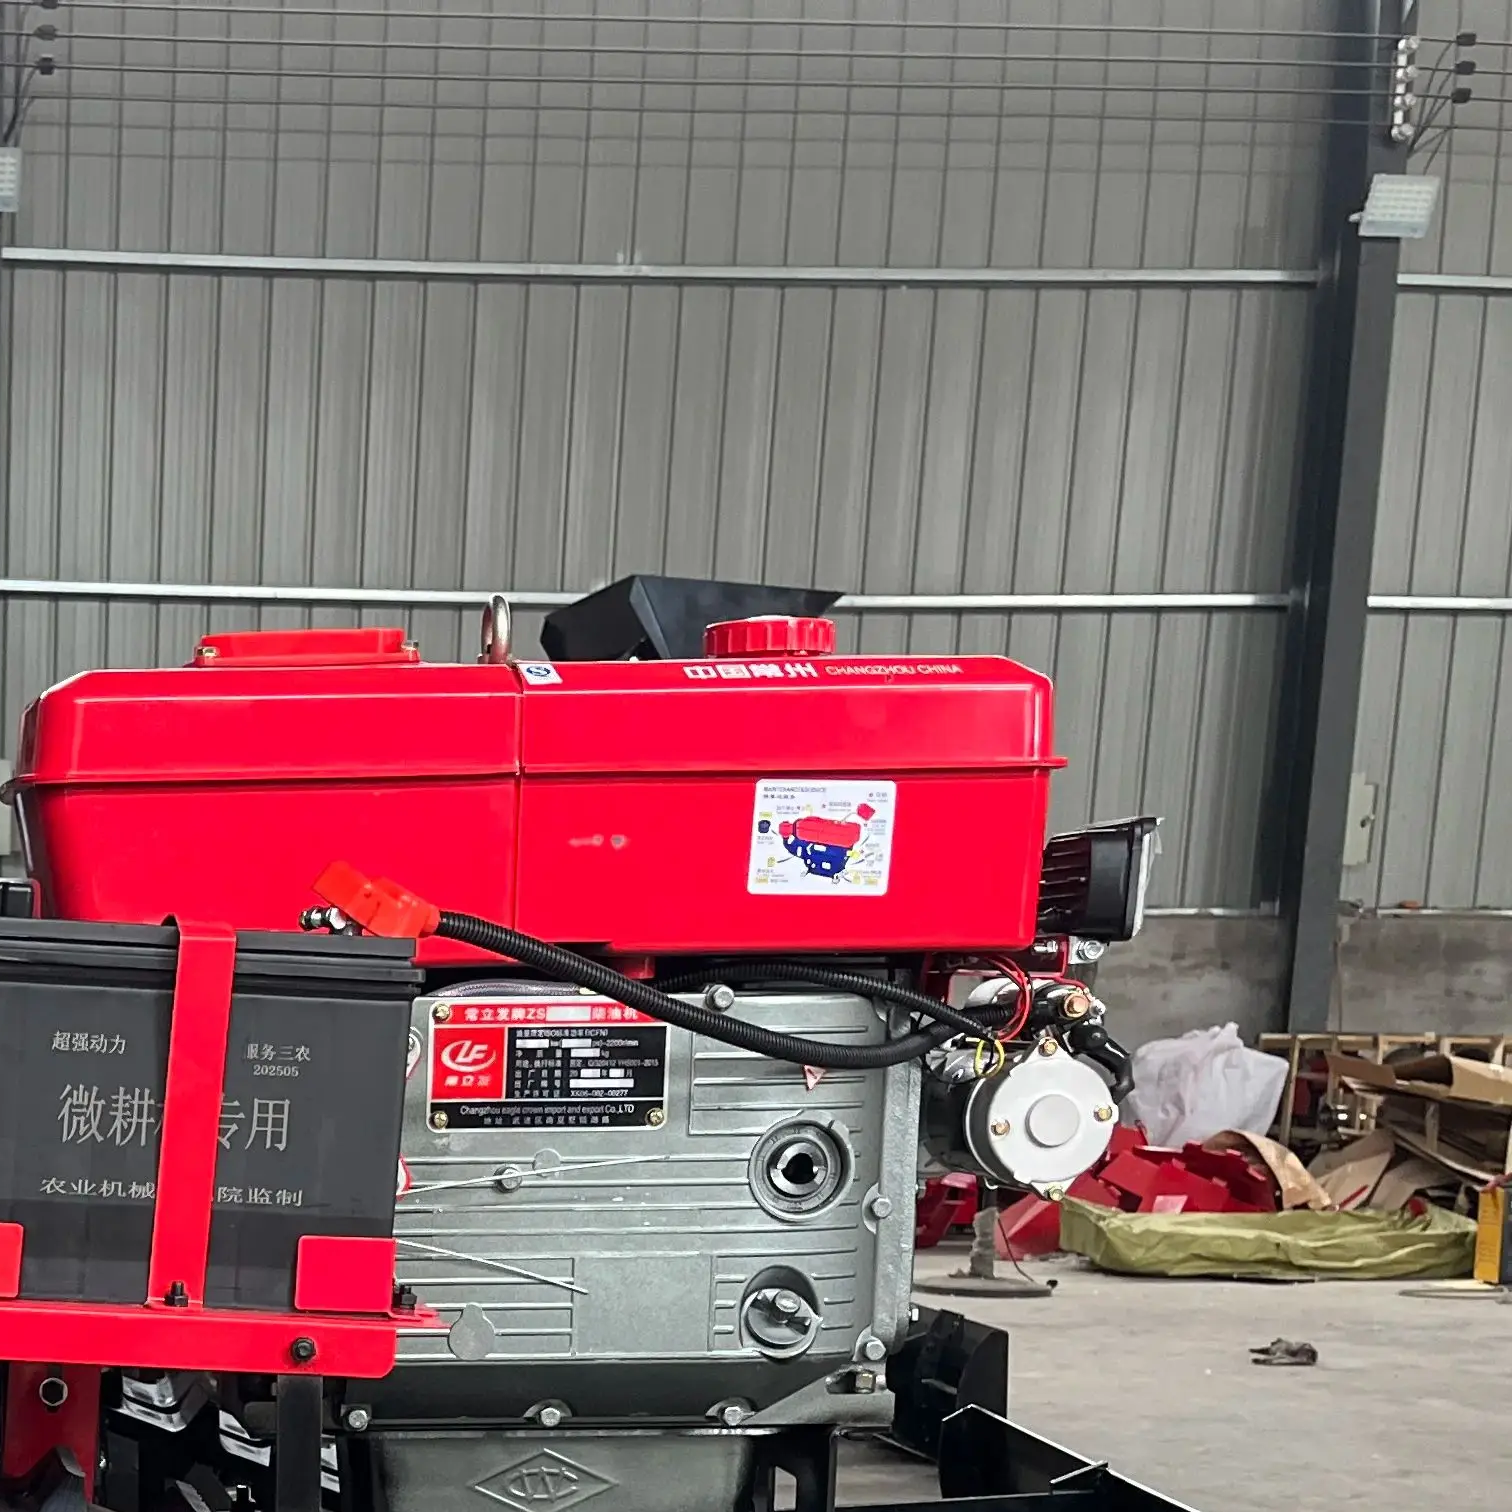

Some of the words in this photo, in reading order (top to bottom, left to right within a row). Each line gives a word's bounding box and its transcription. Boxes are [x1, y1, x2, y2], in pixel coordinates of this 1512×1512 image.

[824, 664, 913, 677] CHANGZHOU
[916, 663, 964, 676] CHINA
[52, 1030, 126, 1055] 超强动力
[246, 1043, 311, 1062] 服务三农
[252, 1064, 299, 1077] 202505
